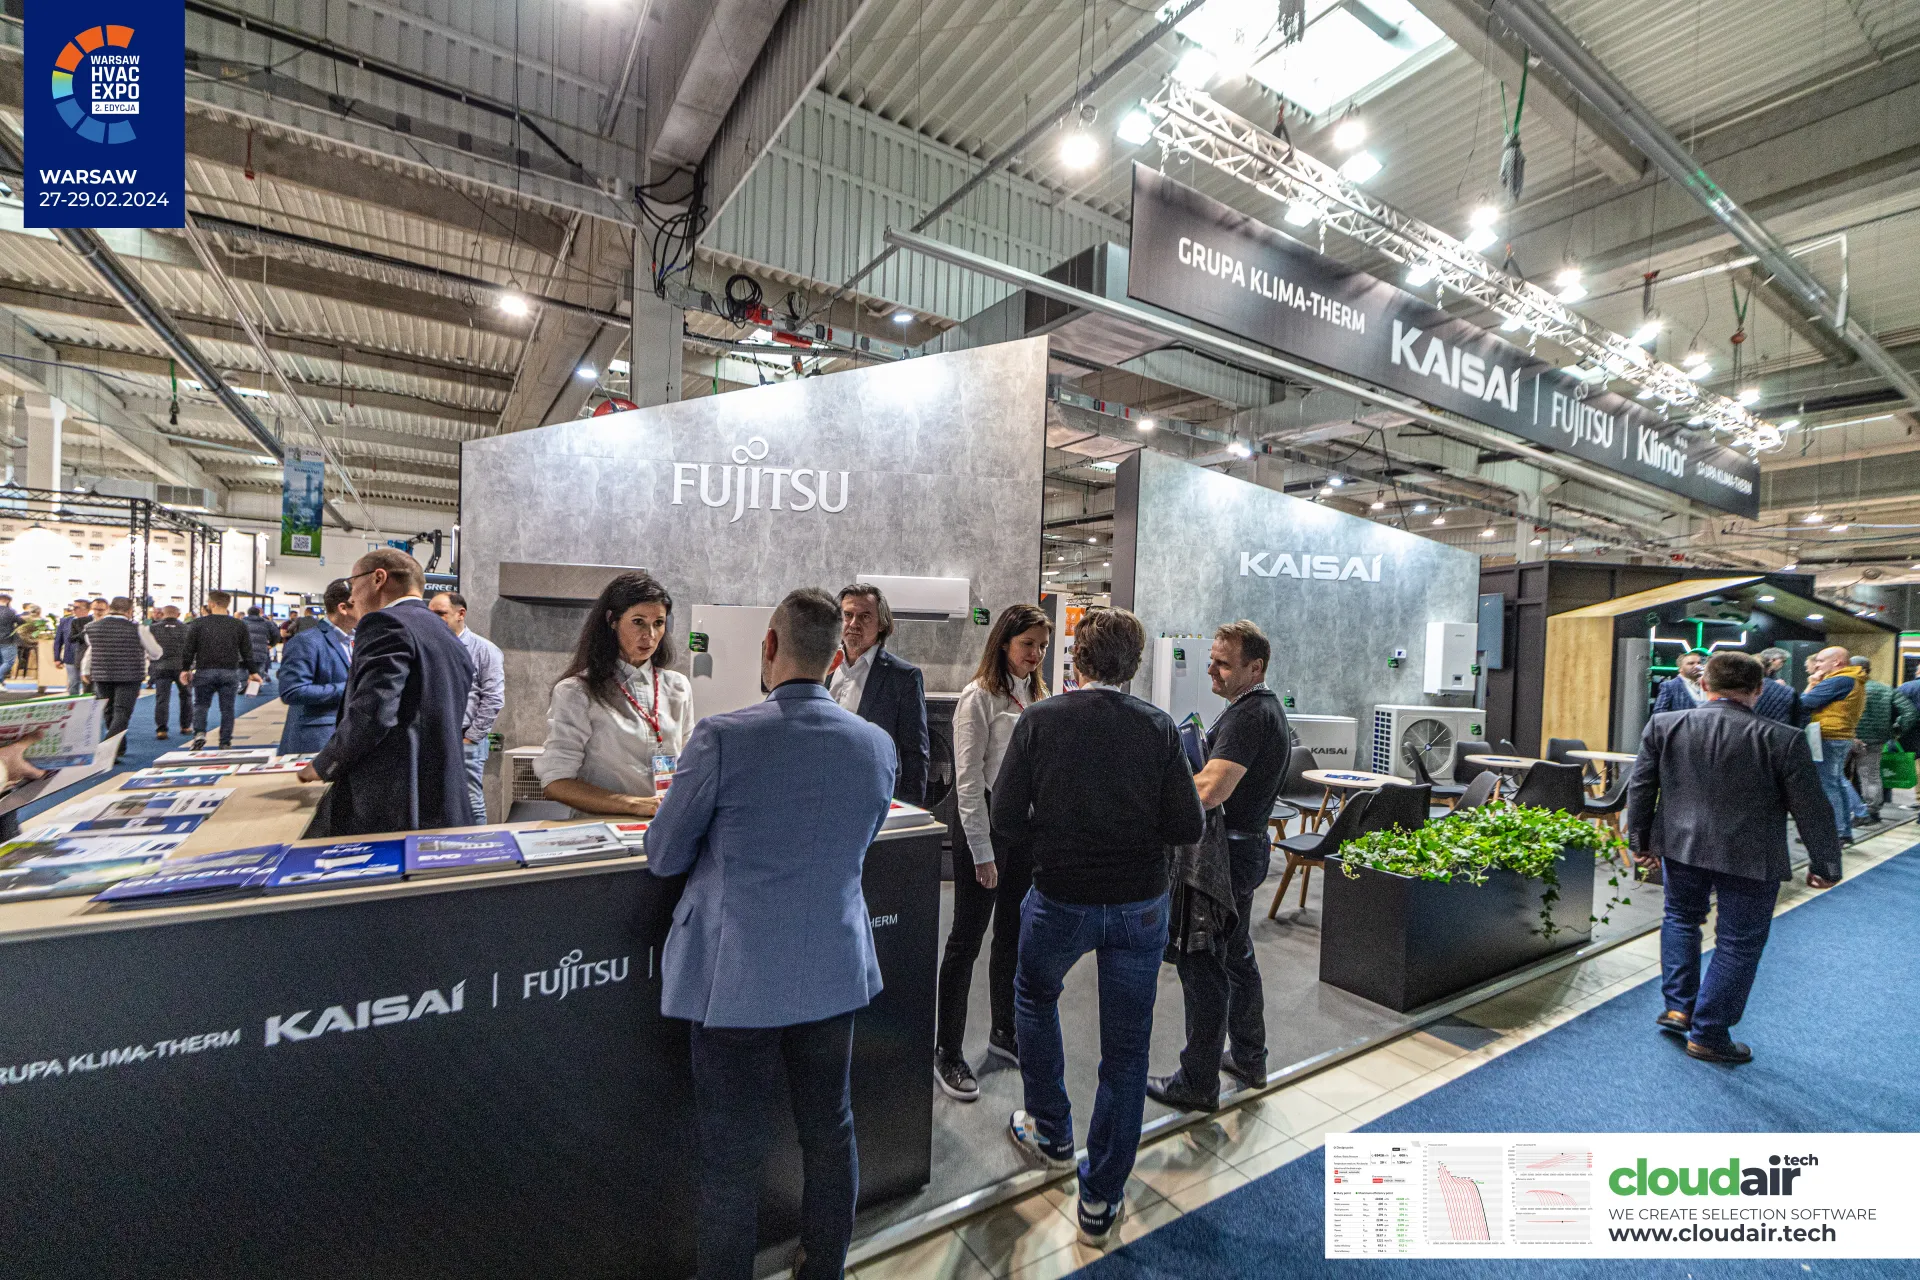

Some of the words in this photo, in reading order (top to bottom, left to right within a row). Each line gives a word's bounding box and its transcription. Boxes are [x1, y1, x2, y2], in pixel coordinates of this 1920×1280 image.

[1178, 236, 1246, 288] GRUPA
[1250, 266, 1366, 334] KLIMA-THERM
[1551, 385, 1615, 448] FUJITSU
[671, 452, 851, 524] FUJITSU
[67, 1028, 241, 1075] KLIMA-THERM
[523, 952, 630, 1001] FUJITSU
